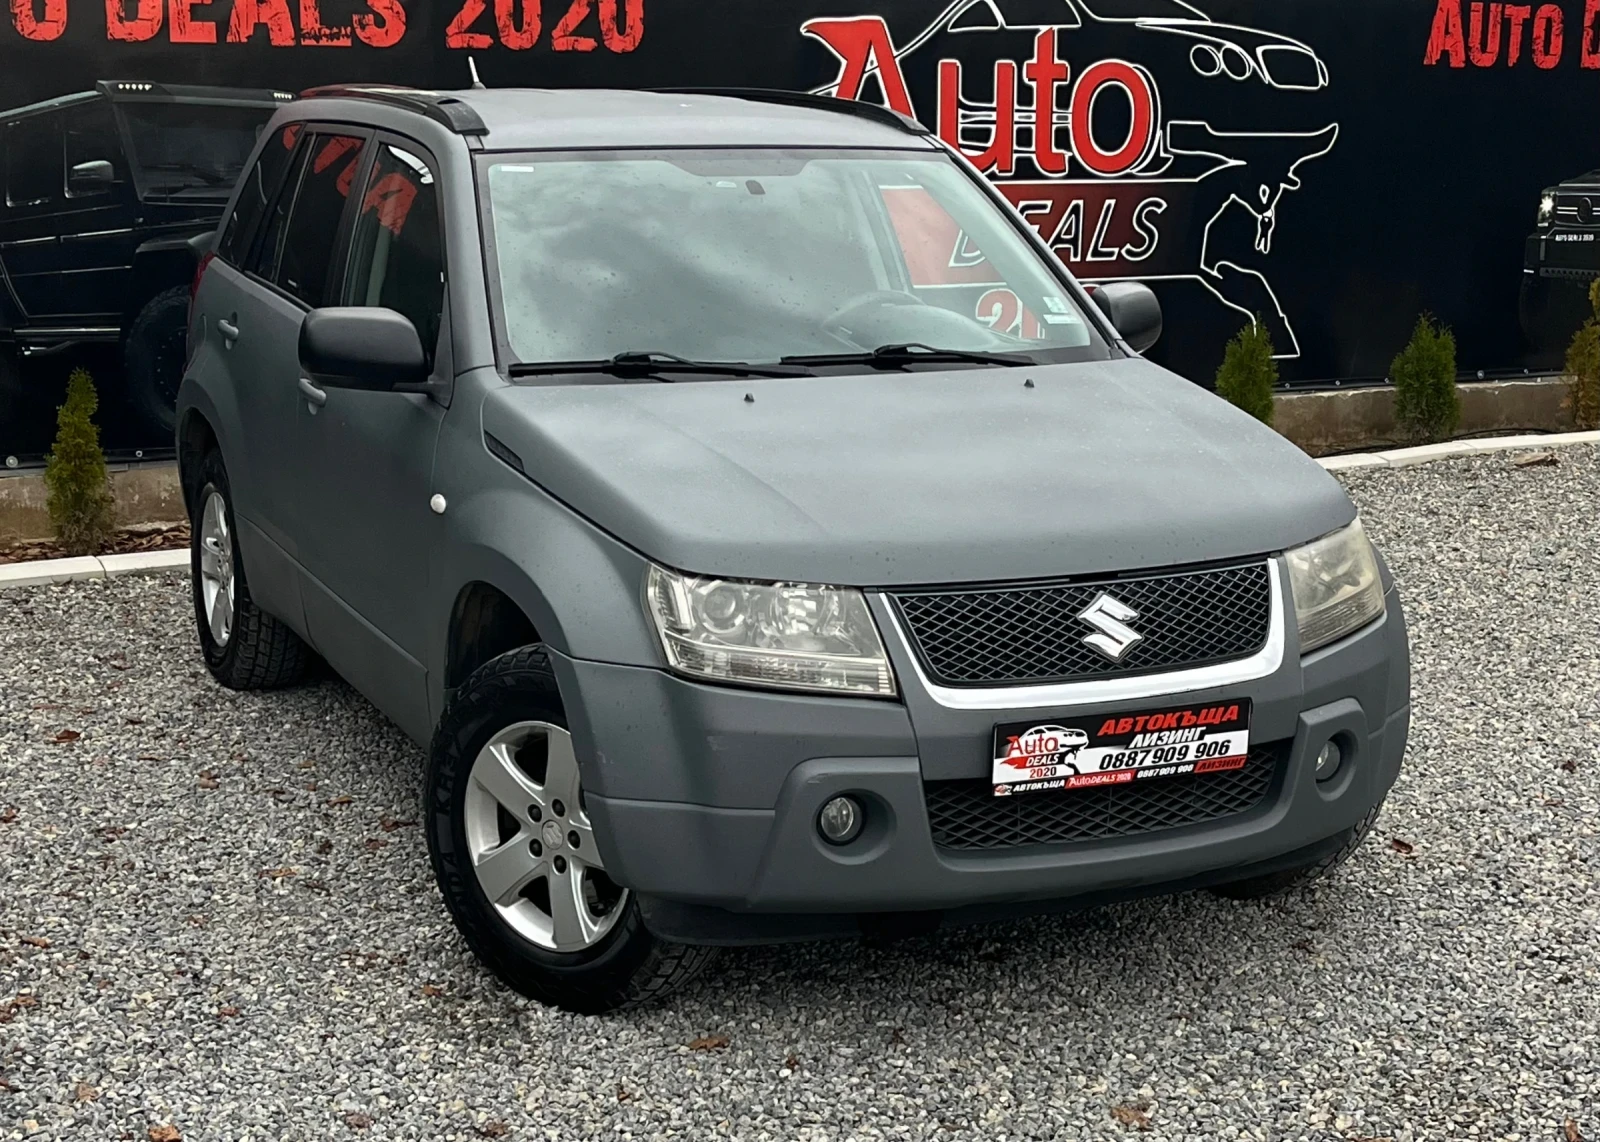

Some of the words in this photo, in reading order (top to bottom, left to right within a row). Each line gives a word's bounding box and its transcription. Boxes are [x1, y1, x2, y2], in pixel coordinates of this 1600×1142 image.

[107, 0, 407, 48] DEALS
[446, 0, 645, 53] 2020
[1423, 0, 1564, 70] AUTO
[801, 16, 1154, 175] Auto
[1097, 705, 1239, 736] АВТОКЪЩА
[1006, 733, 1060, 757] Auto
[1128, 726, 1207, 749] ЛИЗИНГ
[1025, 754, 1060, 767] DEALS
[1098, 749, 1152, 770] 0887
[1151, 745, 1190, 764] 909
[1194, 739, 1232, 759] 906
[1013, 779, 1066, 792] АВТОКЪЩА
[1029, 766, 1057, 779] 2020
